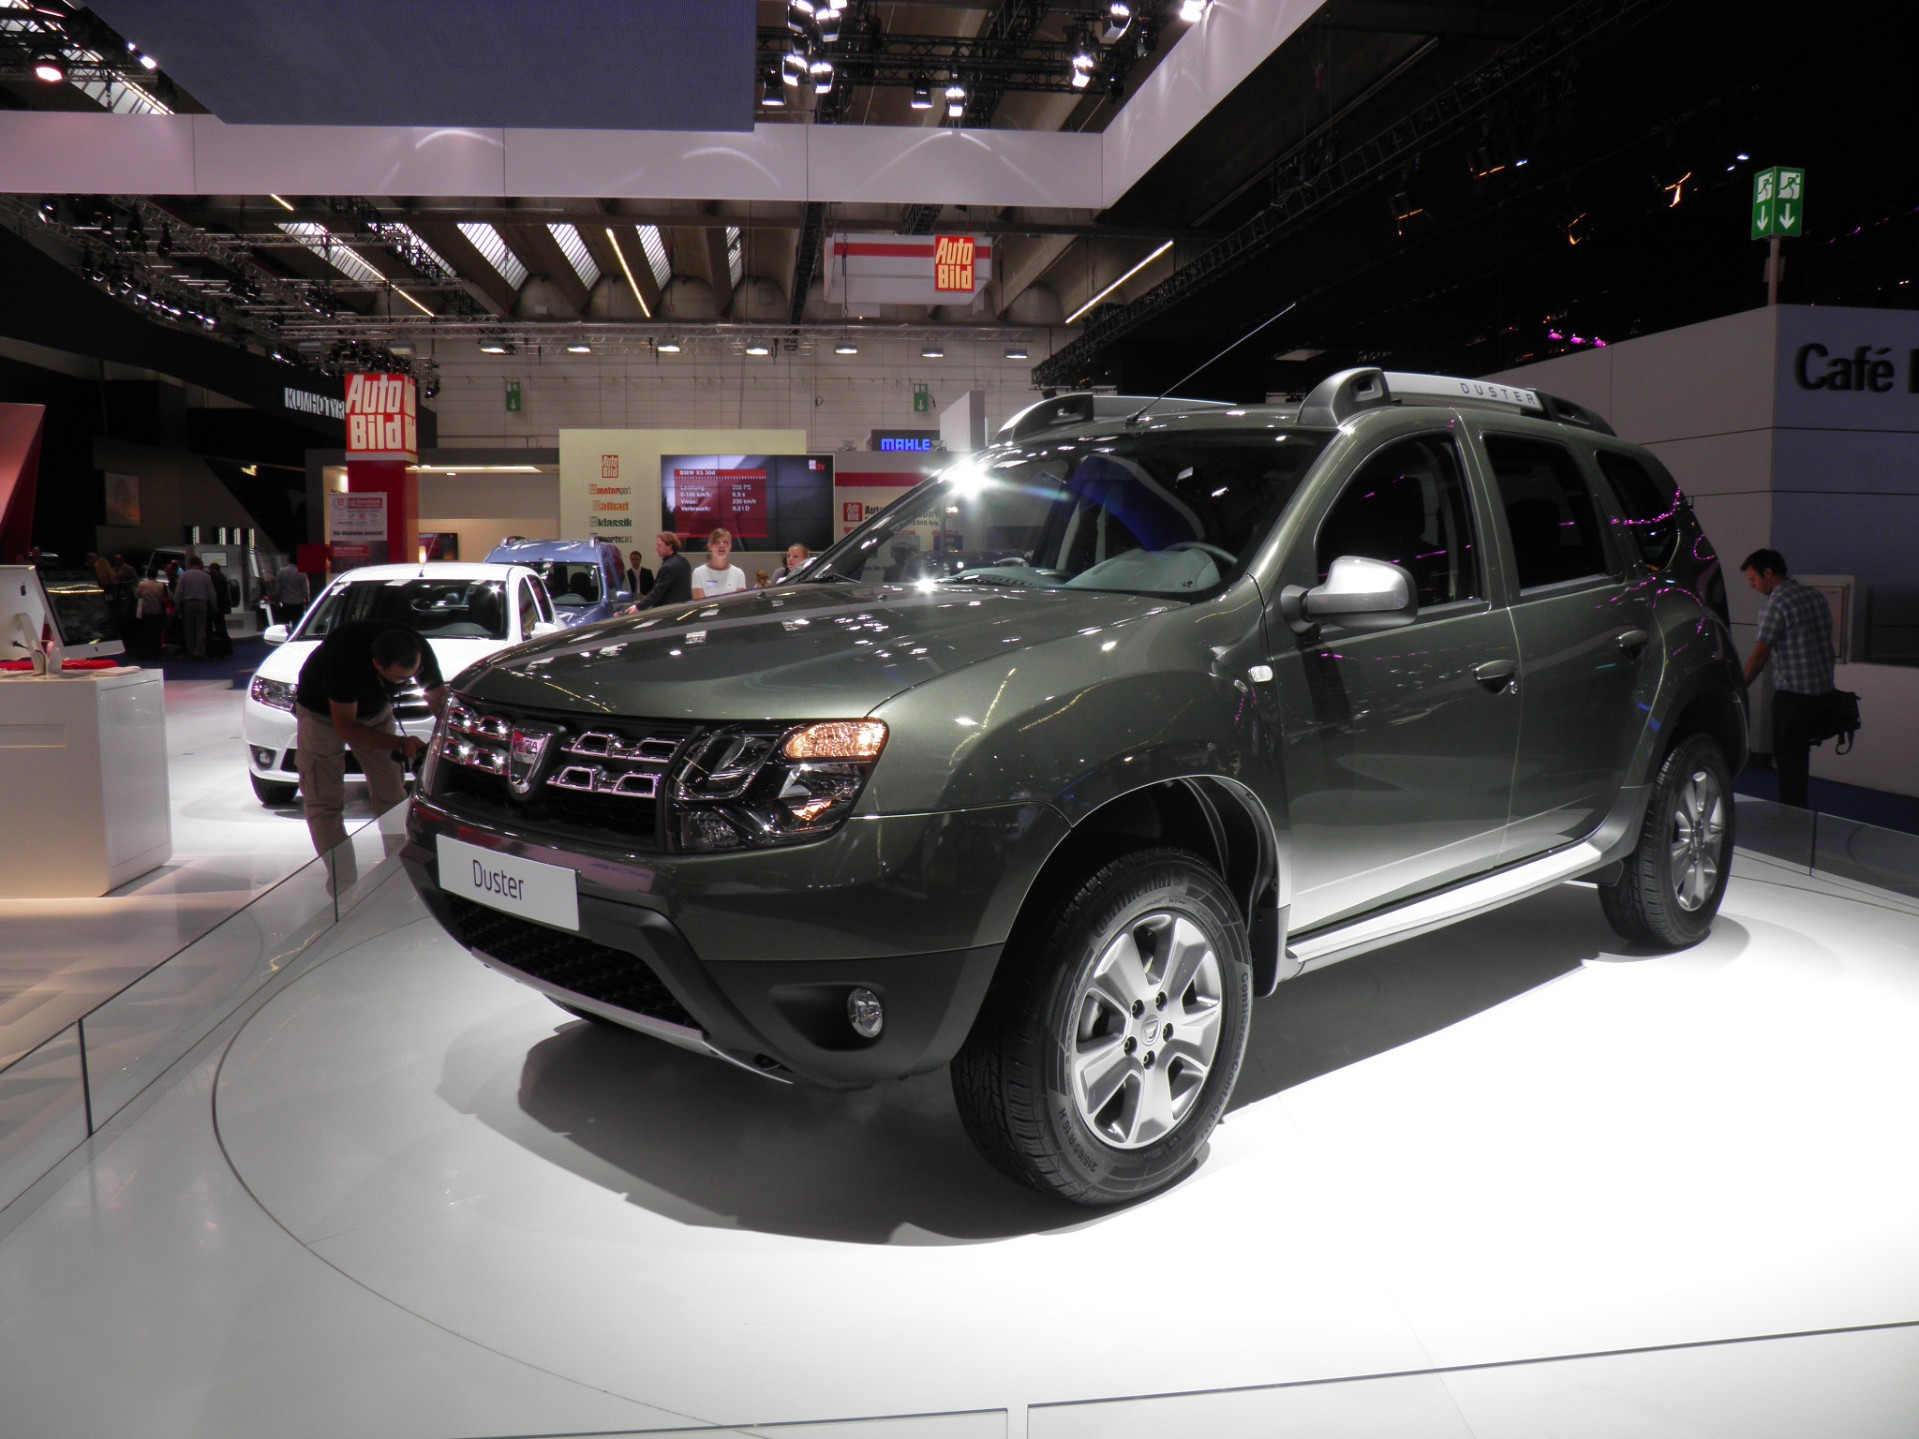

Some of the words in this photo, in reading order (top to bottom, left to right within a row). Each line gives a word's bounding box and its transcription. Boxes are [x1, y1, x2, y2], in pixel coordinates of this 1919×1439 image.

[935, 238, 973, 265] Auto
[938, 265, 973, 289] Bild
[1794, 343, 1895, 393] Café
[345, 374, 403, 413] Auto
[1460, 382, 1536, 405] DUSTER
[350, 414, 402, 450] Bild
[881, 438, 930, 452] MAHLE
[598, 518, 633, 527] klassik
[472, 859, 524, 900] Duster
